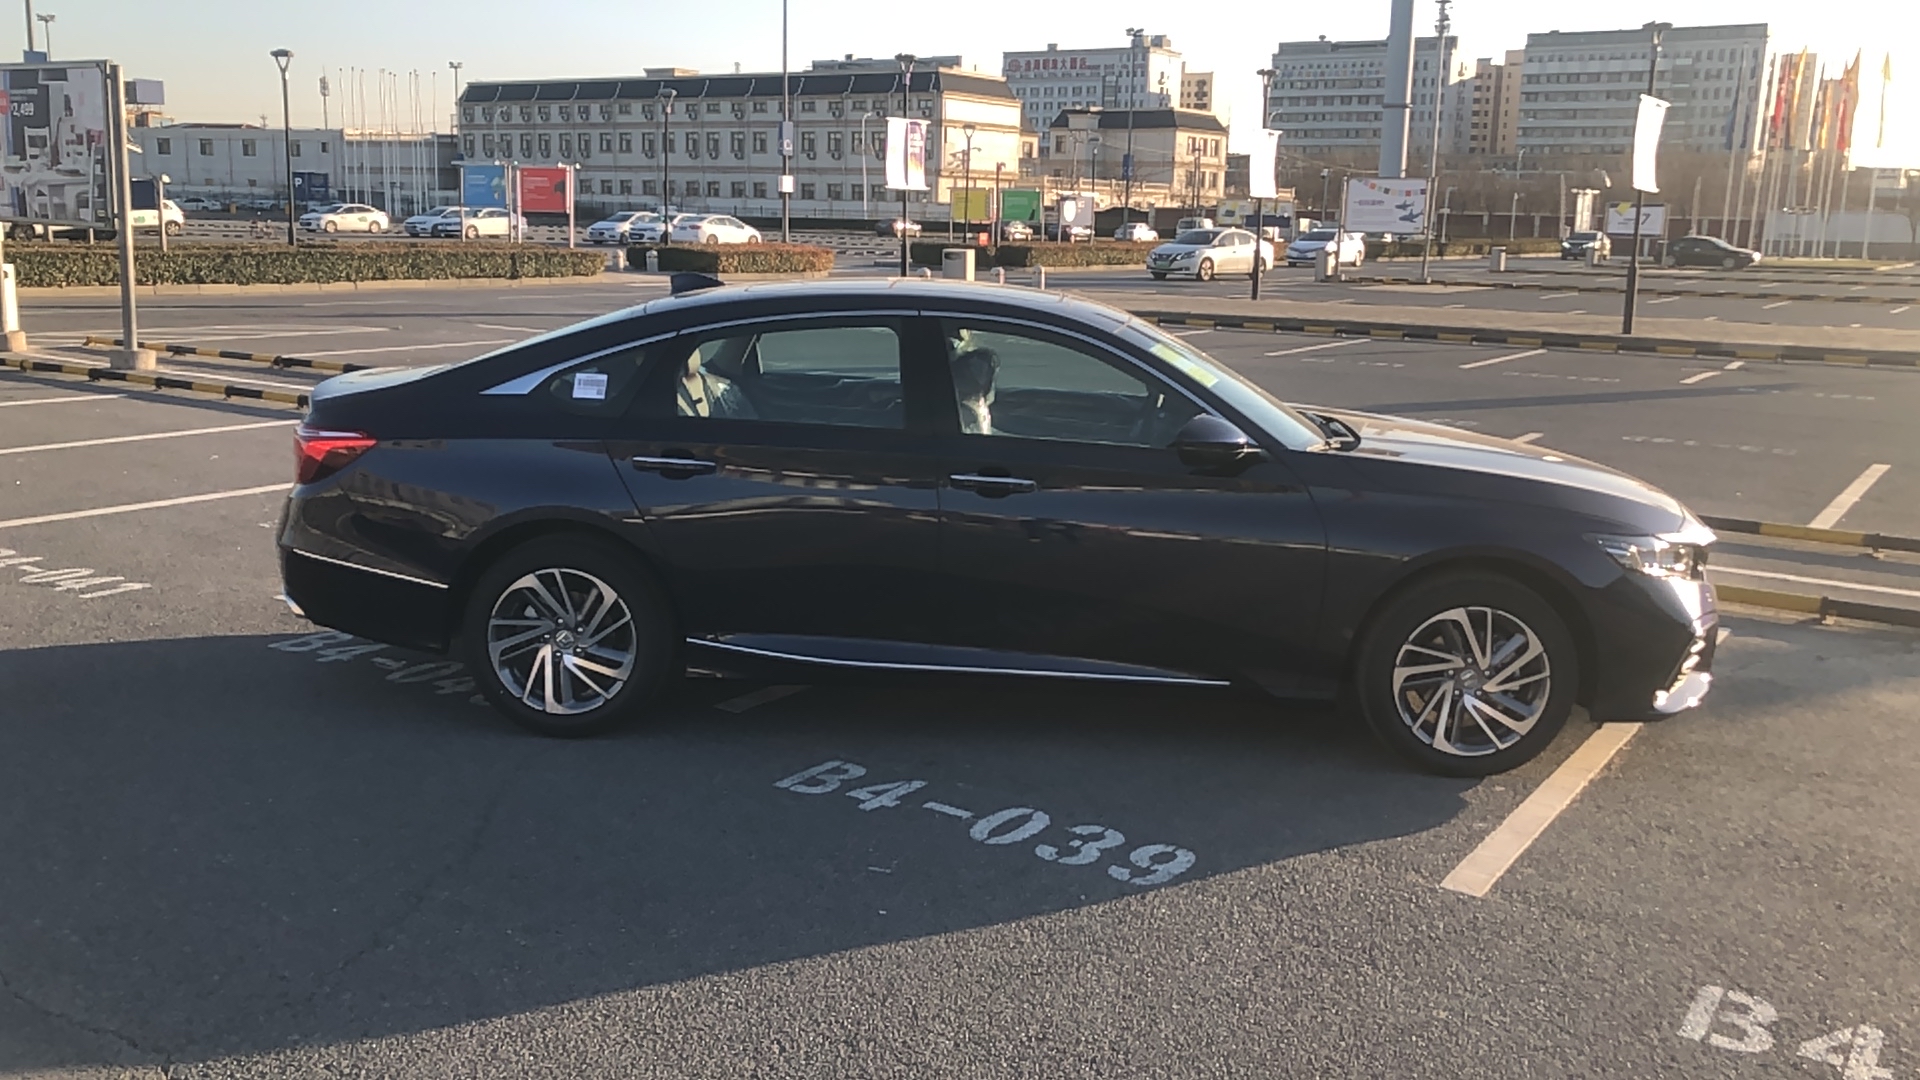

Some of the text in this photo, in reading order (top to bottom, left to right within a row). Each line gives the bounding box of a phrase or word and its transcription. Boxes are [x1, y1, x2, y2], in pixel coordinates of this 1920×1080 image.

[294, 177, 303, 188] P
[0, 549, 152, 599] 4-041
[773, 760, 1196, 885] B4-039
